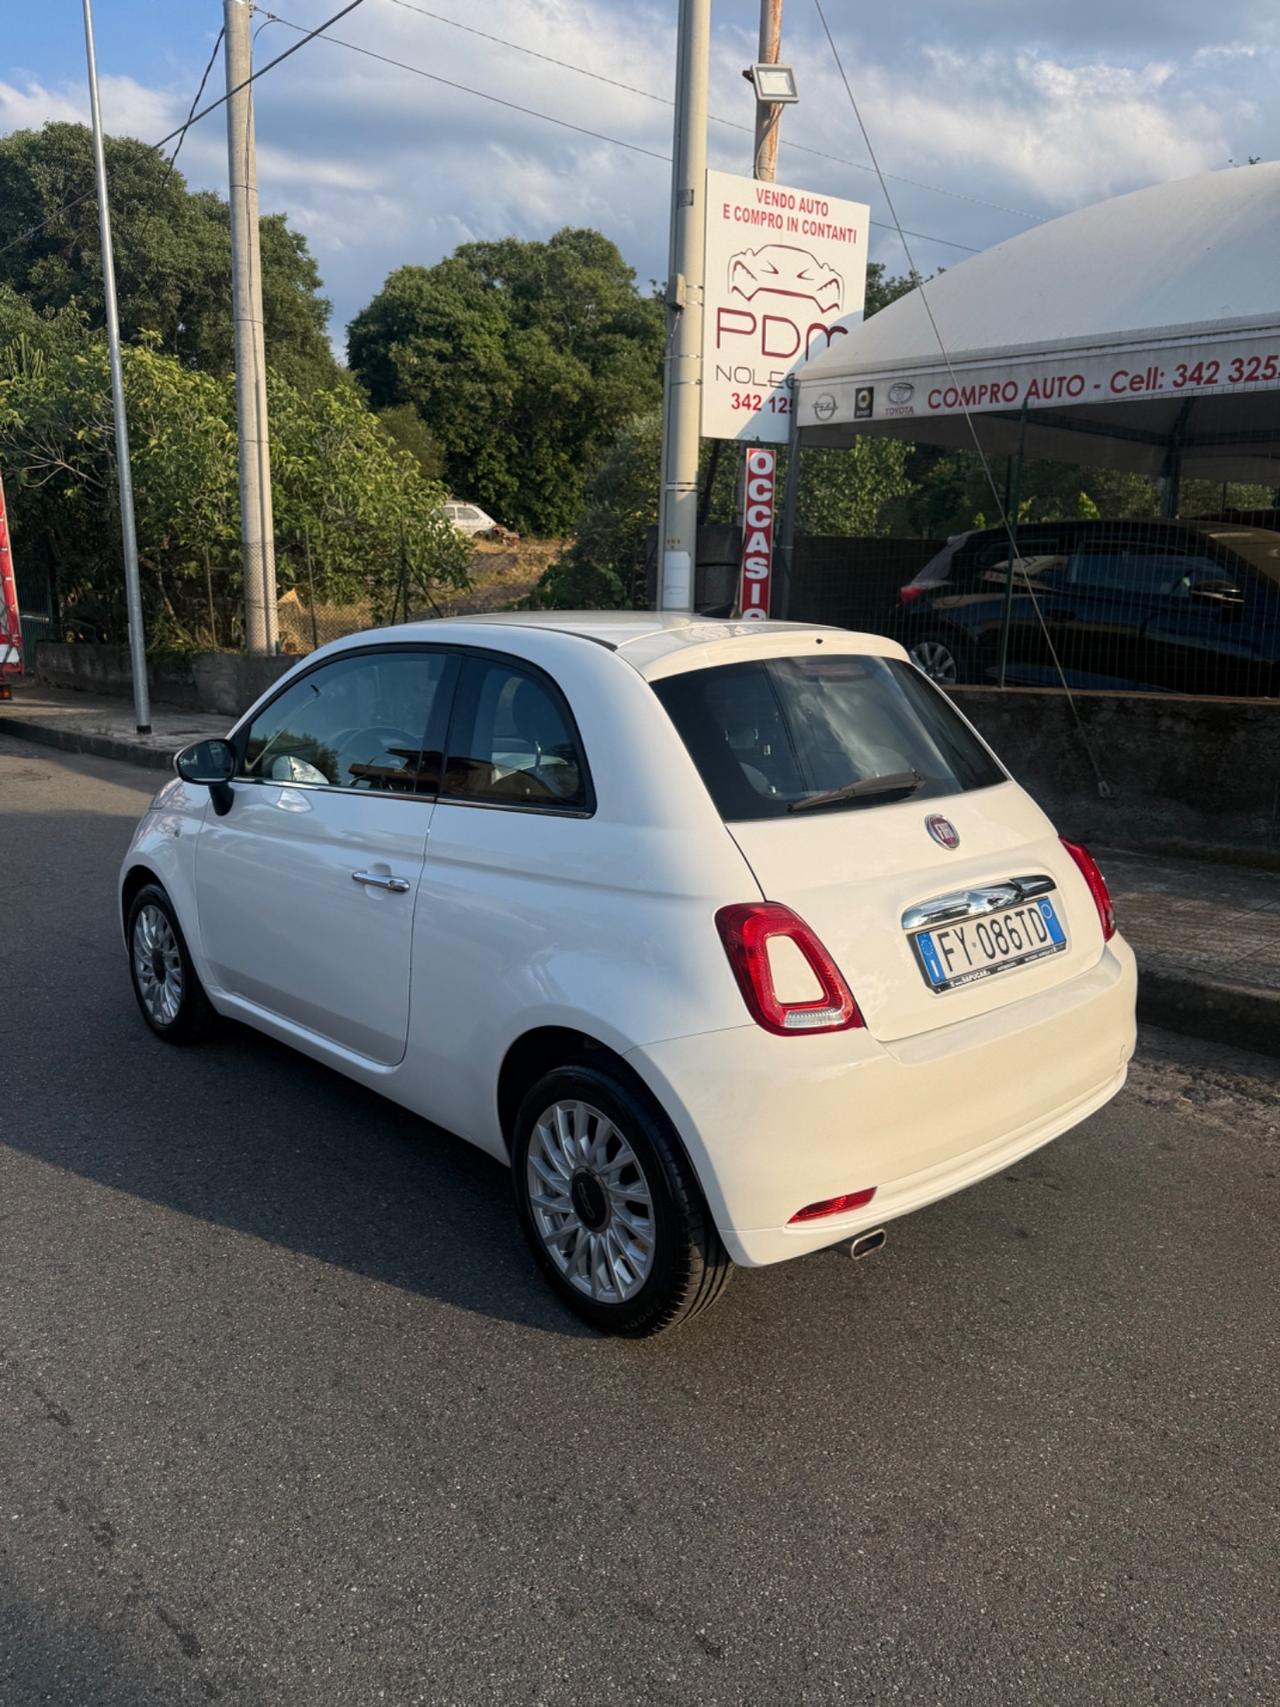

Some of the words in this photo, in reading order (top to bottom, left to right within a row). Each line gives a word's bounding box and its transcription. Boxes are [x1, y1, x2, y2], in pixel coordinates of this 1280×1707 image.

[756, 188, 795, 210] VENDO
[799, 197, 829, 217] AUTO
[723, 203, 730, 219] E
[734, 206, 783, 229] COMPRO
[787, 216, 798, 232] IN
[802, 219, 857, 244] CONTANTI
[928, 380, 1018, 410] COMPRO
[1026, 374, 1085, 400] AUTO
[1110, 366, 1165, 394] Cell:
[1172, 360, 1220, 388] 342
[1228, 355, 1280, 383] 325
[731, 392, 762, 412] 342
[885, 405, 914, 416] TOYOTA
